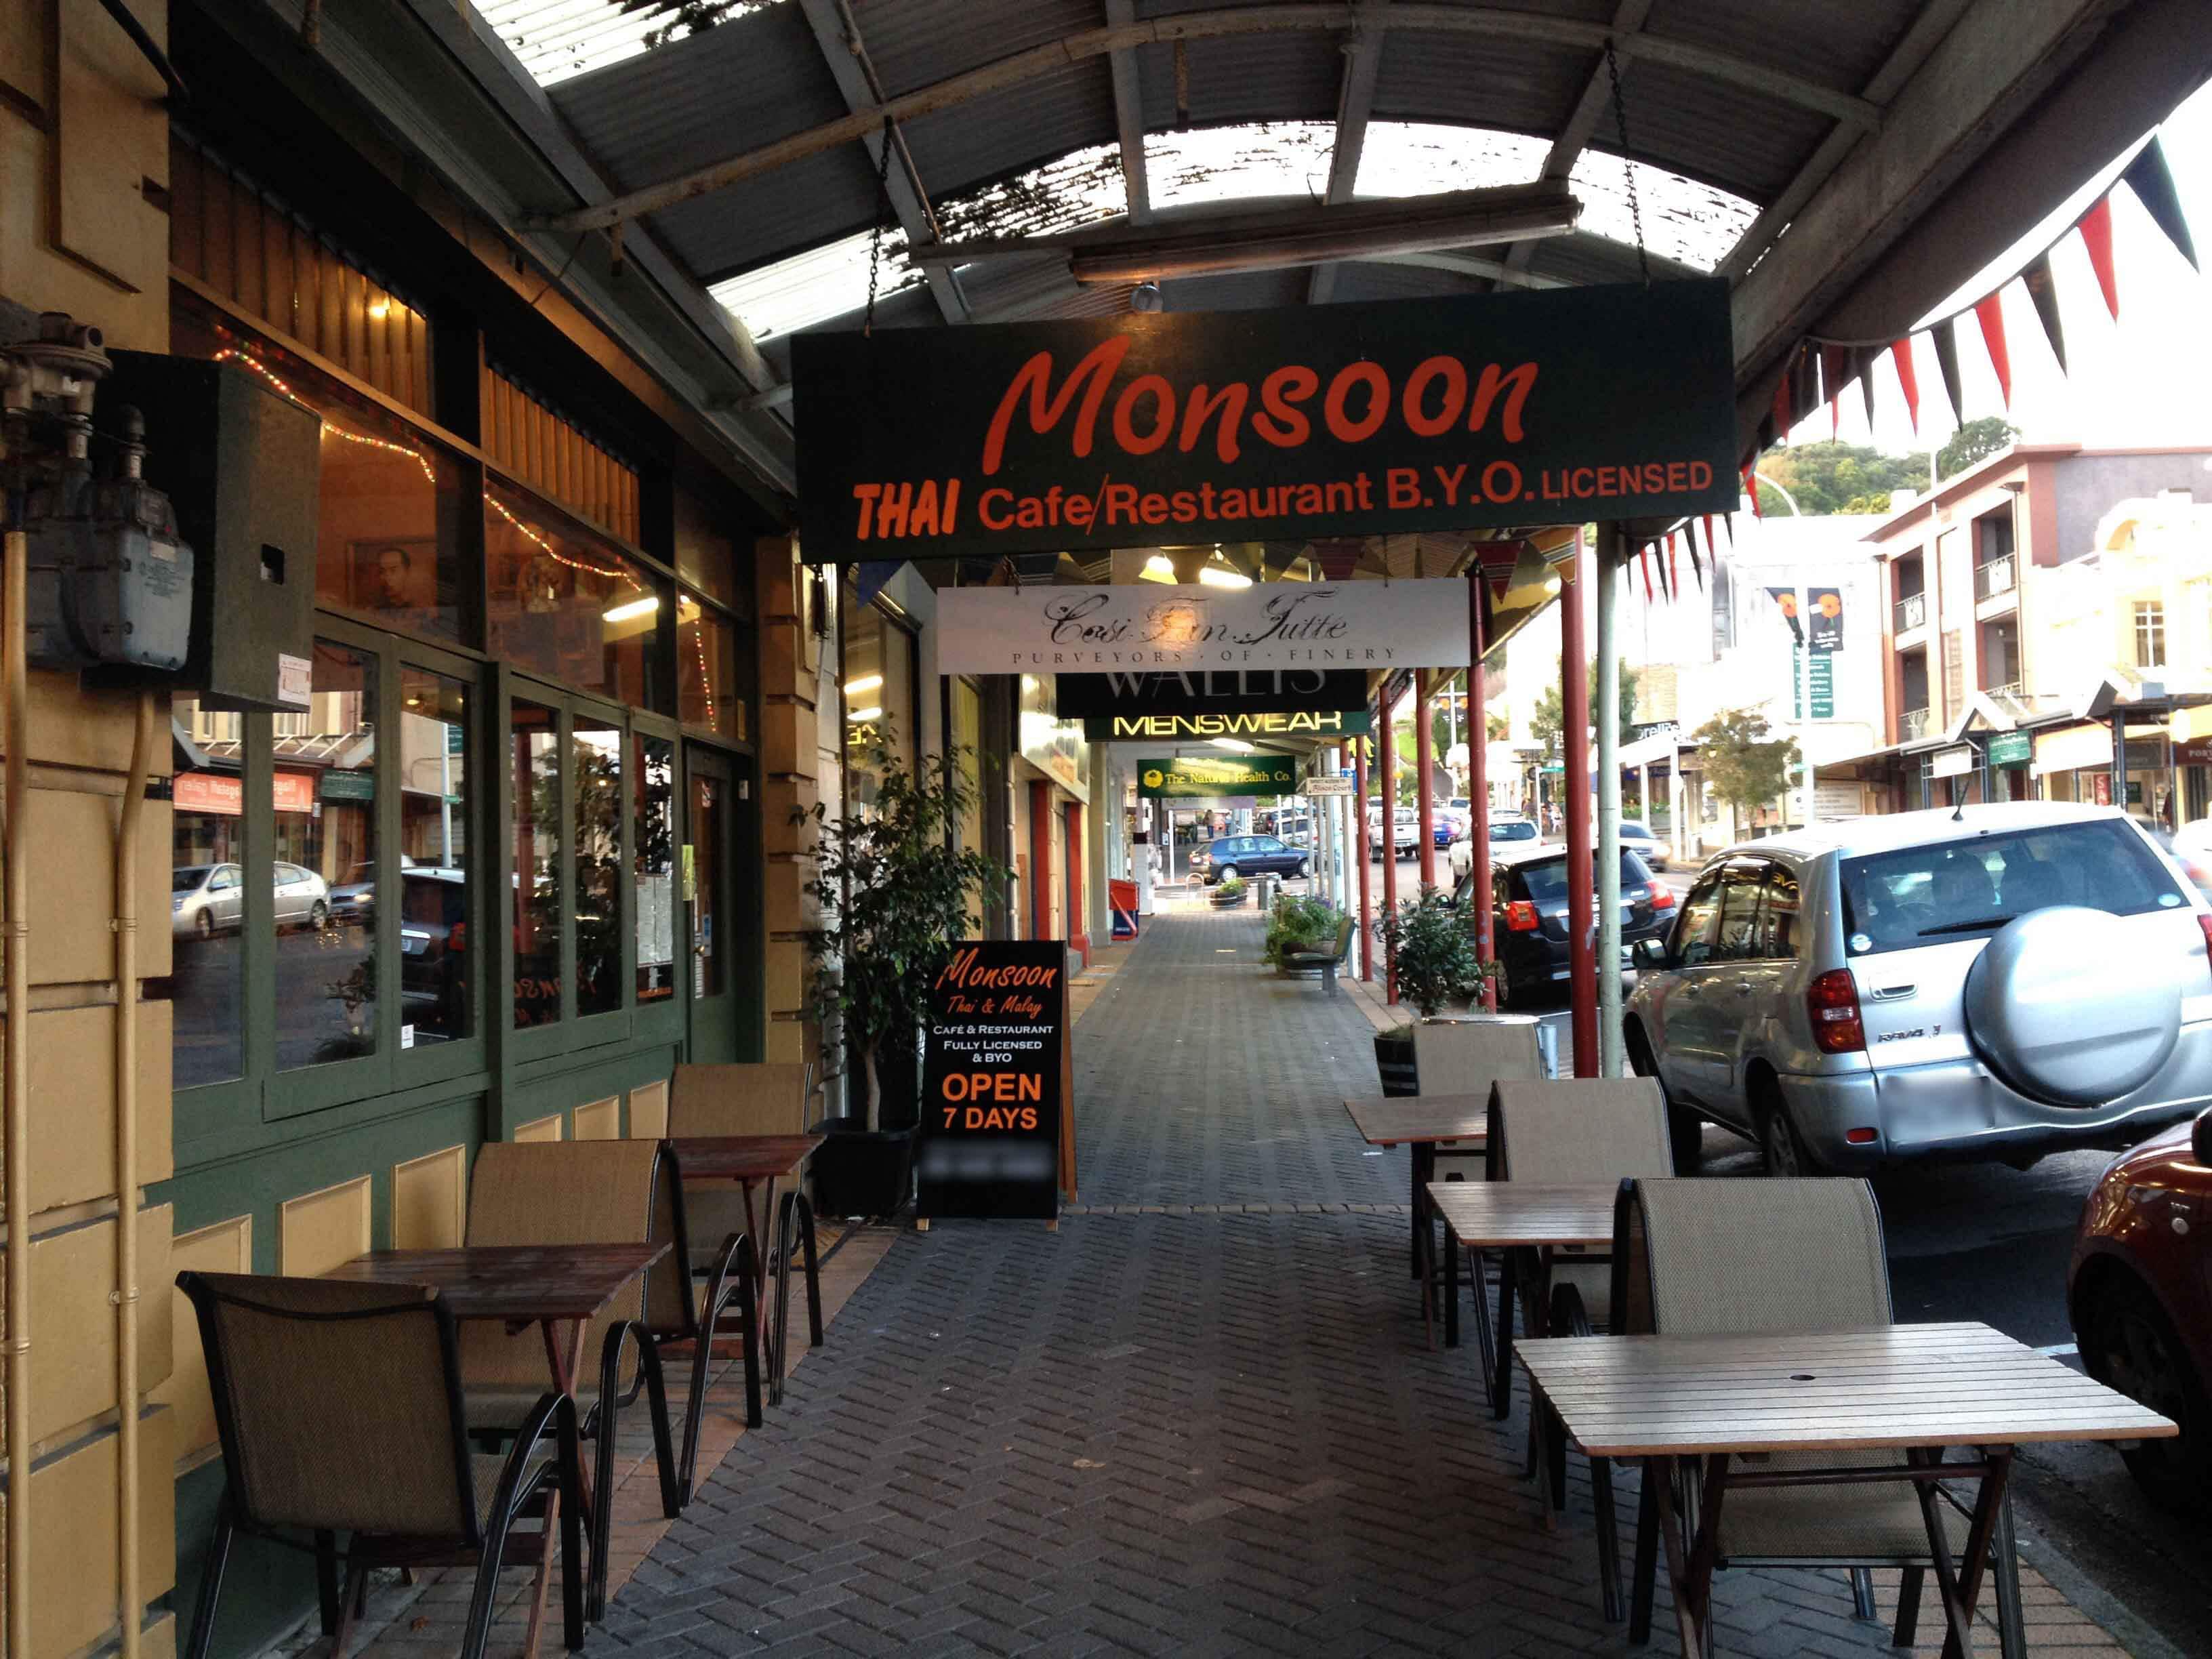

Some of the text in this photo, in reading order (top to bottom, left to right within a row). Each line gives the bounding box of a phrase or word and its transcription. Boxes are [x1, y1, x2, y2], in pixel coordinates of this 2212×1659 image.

[982, 334, 1538, 476] Monsoon
[853, 478, 960, 541] THAI
[1387, 460, 1535, 508] B.Y.O.
[1542, 461, 1713, 500] LICENSED
[1235, 586, 1348, 645] Tutte
[1012, 647, 1397, 664] PURVEYORS OF FINERY
[1113, 711, 1343, 736] MENSWEAR
[1165, 774, 1186, 785] The
[1191, 773, 1232, 784] Natur
[1235, 771, 1269, 783] Health
[935, 947, 1058, 990] Monsoon
[947, 994, 1042, 1019] Thai & Malay
[966, 1024, 976, 1035] &
[978, 1024, 1054, 1035] RESTAURANT
[1877, 1028, 1925, 1043] RAV4
[943, 1040, 1042, 1050] FULLY LICENSED
[972, 1052, 1012, 1063] & BYO
[942, 1073, 1042, 1102] OPEN
[943, 1107, 1038, 1130] 7 DAYS
